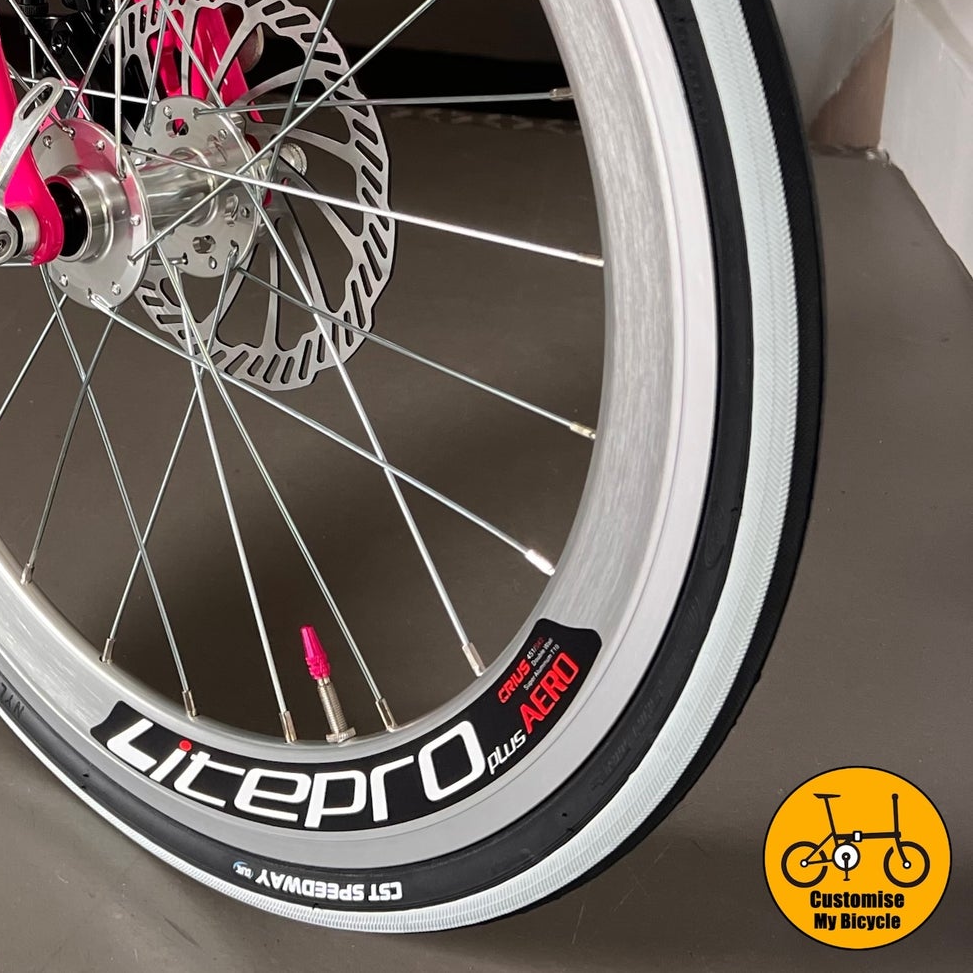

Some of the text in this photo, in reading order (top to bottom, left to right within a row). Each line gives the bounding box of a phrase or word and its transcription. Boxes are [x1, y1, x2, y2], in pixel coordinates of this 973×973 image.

[498, 658, 531, 704] CRIUS
[519, 652, 580, 735] AERO
[254, 868, 365, 902] SPEEDWAY
[368, 881, 403, 901] CST
